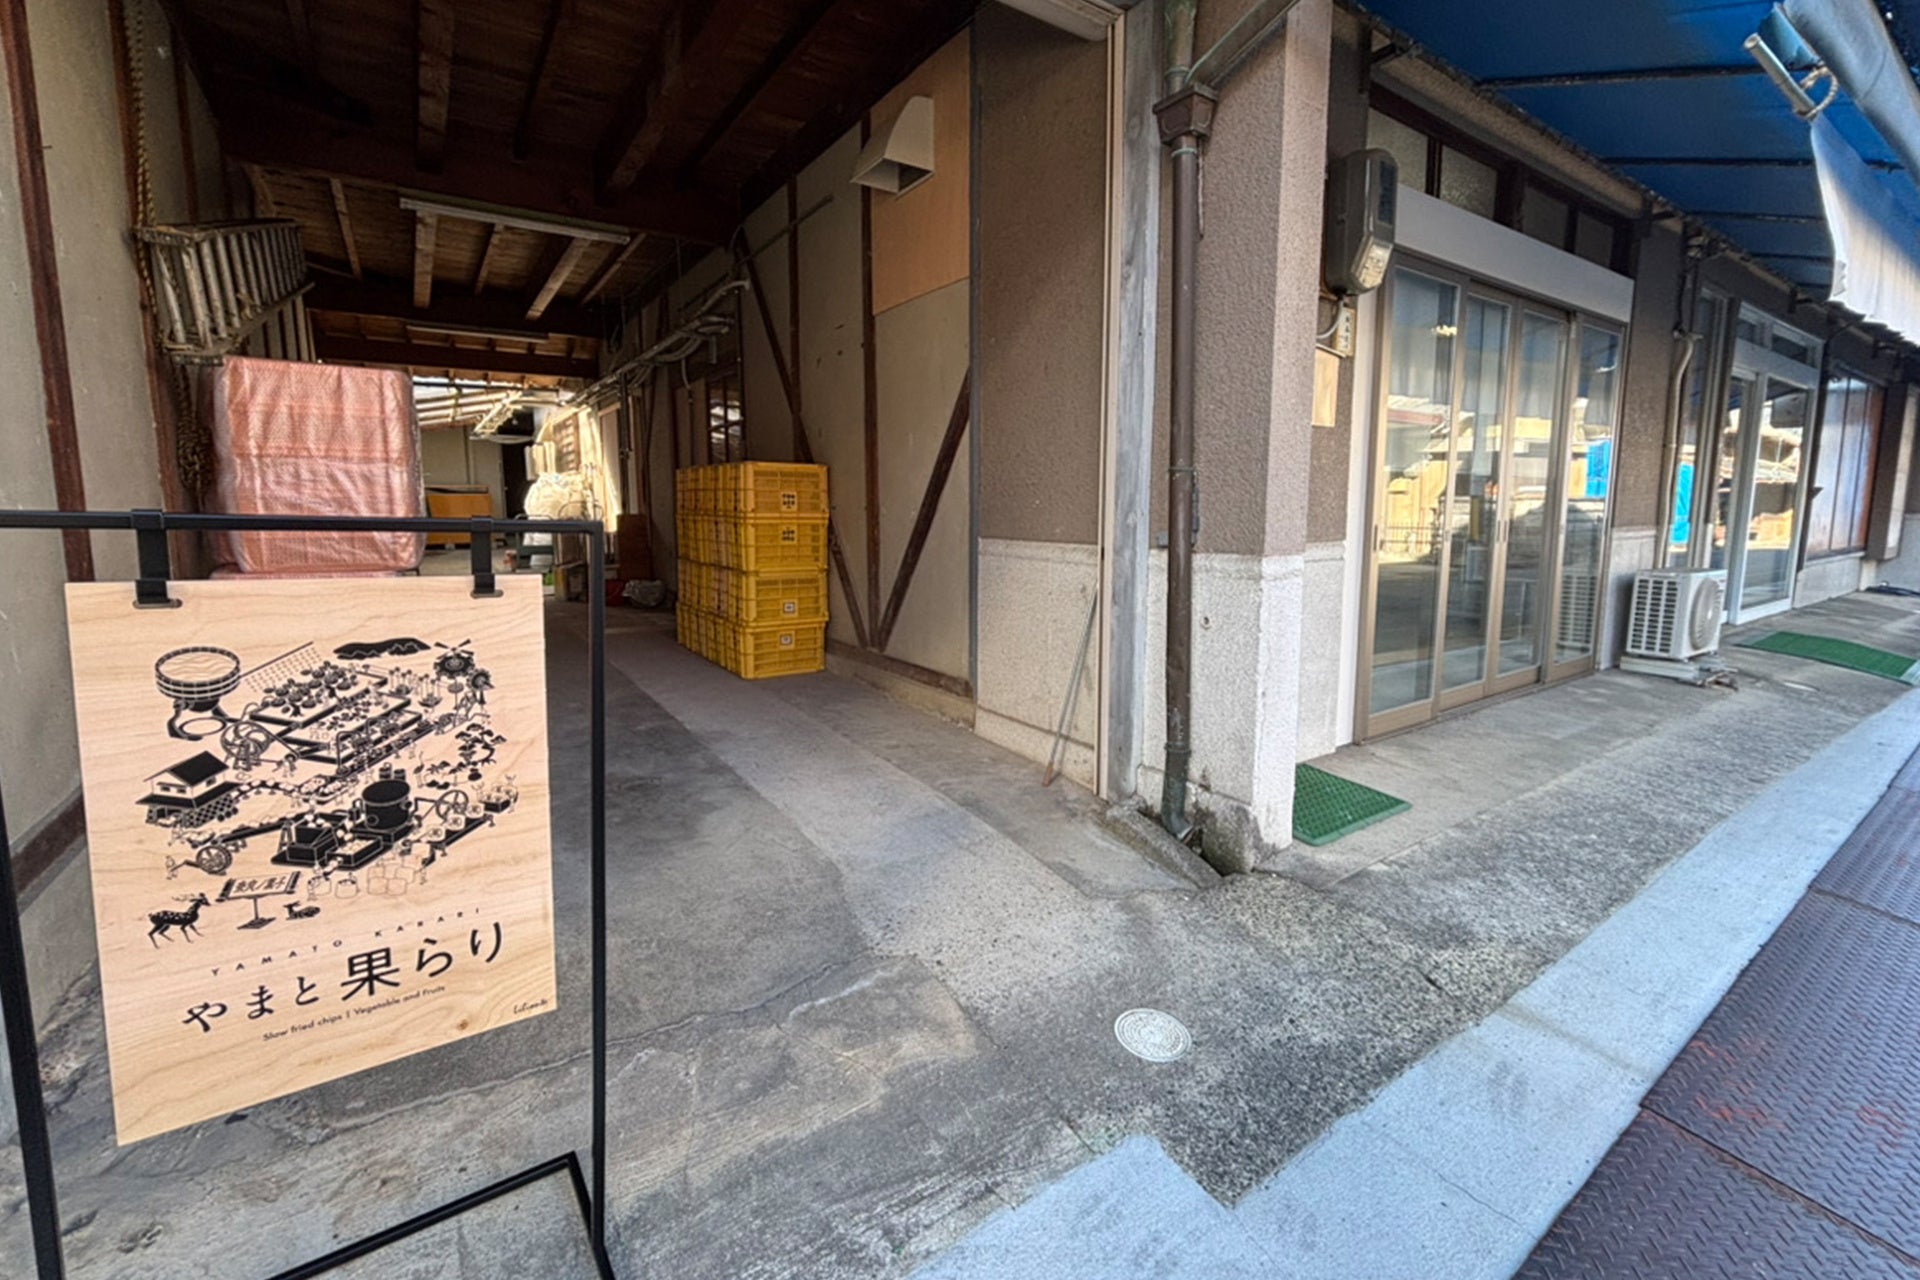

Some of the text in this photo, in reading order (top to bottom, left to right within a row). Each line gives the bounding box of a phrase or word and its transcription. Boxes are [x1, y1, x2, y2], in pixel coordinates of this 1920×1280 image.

[212, 908, 480, 977] YAMATO KARARI
[181, 921, 503, 1034] やまと果らり
[291, 1021, 314, 1034] fried
[317, 1014, 342, 1027] chips
[353, 997, 400, 1015] Vegetable
[402, 991, 420, 1002] and
